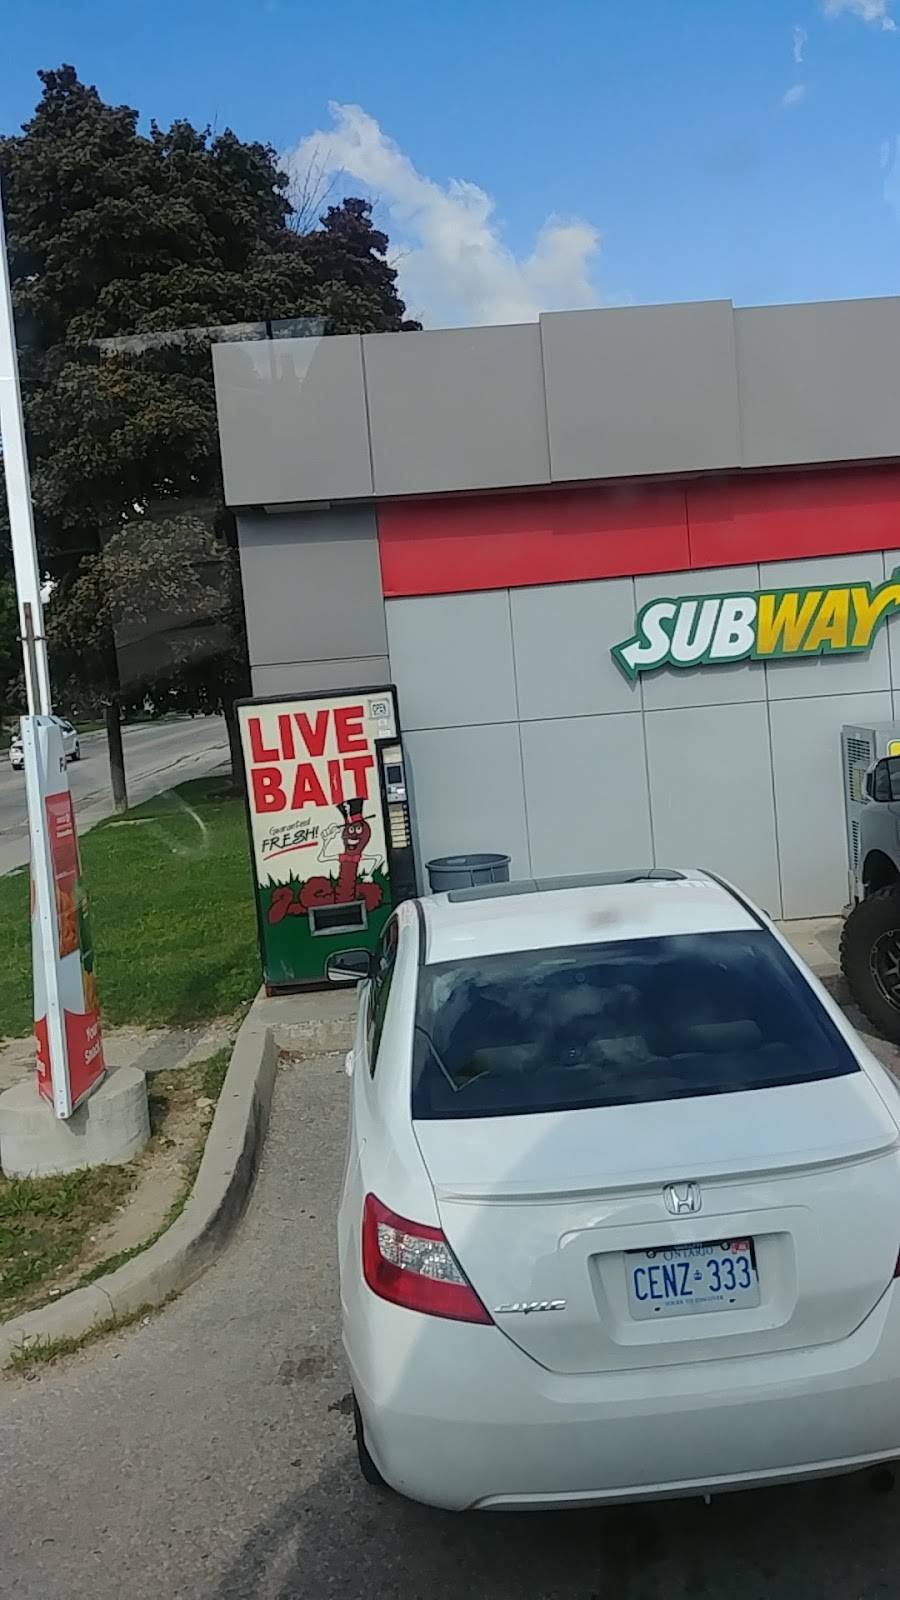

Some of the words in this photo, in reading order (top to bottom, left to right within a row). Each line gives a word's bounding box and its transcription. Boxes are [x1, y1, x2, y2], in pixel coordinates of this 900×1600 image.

[620, 584, 900, 670] SUBWAY
[248, 705, 368, 763] LIVE
[251, 754, 374, 814] BAIT
[261, 825, 320, 853] FRESH!
[633, 1262, 693, 1301] CENZ
[706, 1256, 751, 1292] 333
[663, 1246, 714, 1261] ONTARIO
